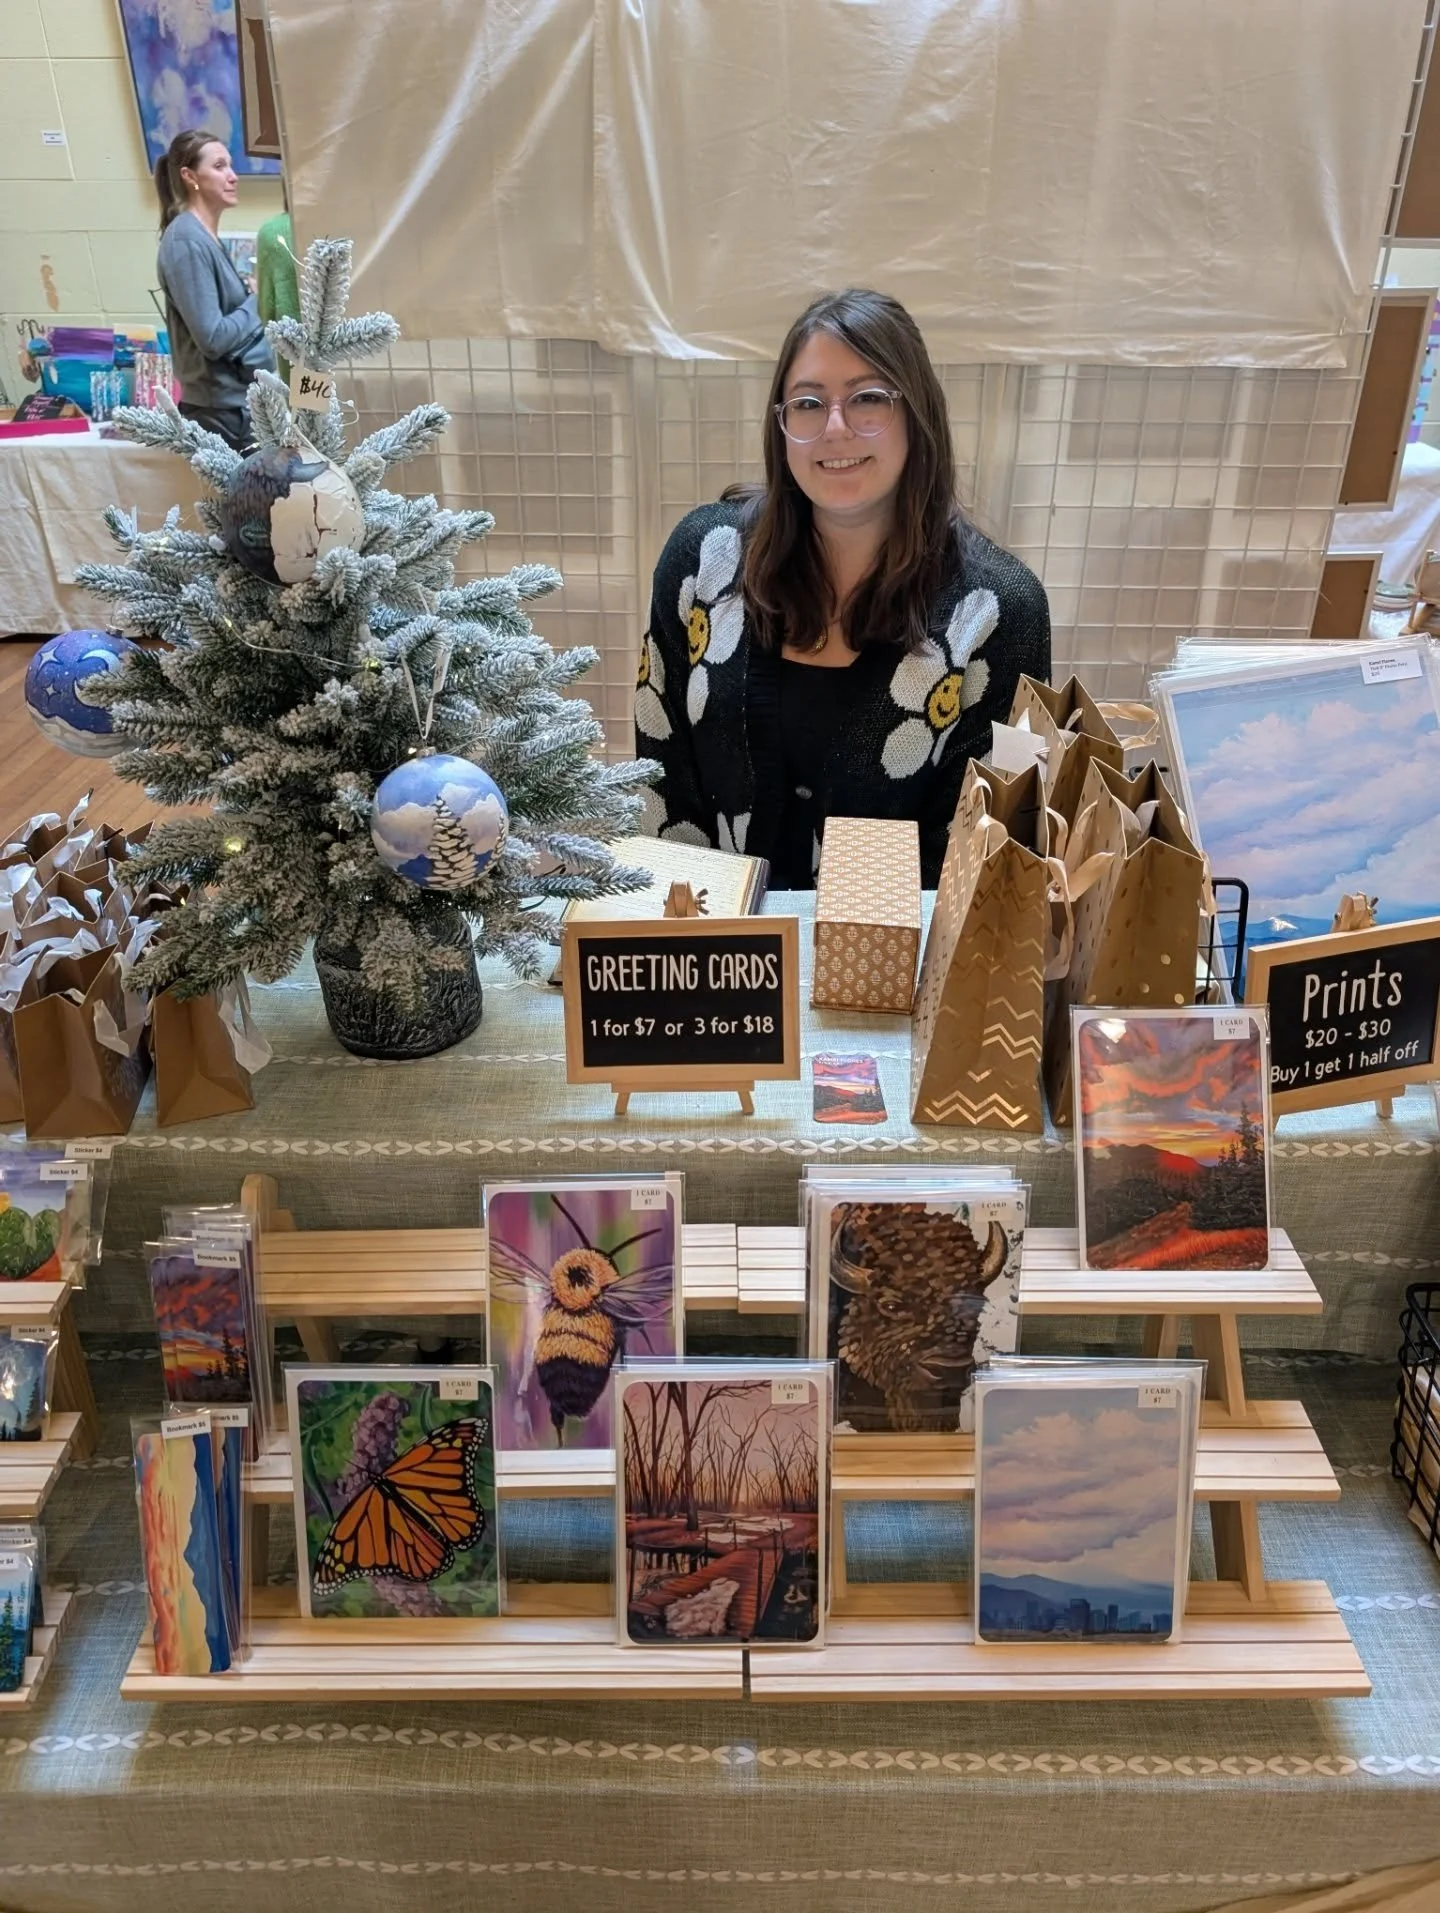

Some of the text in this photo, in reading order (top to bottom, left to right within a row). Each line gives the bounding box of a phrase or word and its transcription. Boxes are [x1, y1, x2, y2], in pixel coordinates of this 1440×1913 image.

[587, 953, 779, 992] GREETING CARDS
[1302, 958, 1403, 1023] Prints
[590, 1015, 775, 1037] 1 for $7 or 3 for $18
[1228, 1027, 1236, 1035] $7
[1305, 1027, 1338, 1049] $20
[1358, 1018, 1391, 1041] $30
[1271, 1040, 1420, 1085] Buy 1 get 1 half off
[197, 1254, 228, 1262] Bookmark
[786, 1392, 794, 1400] $7
[167, 1423, 198, 1433] Bookmark
